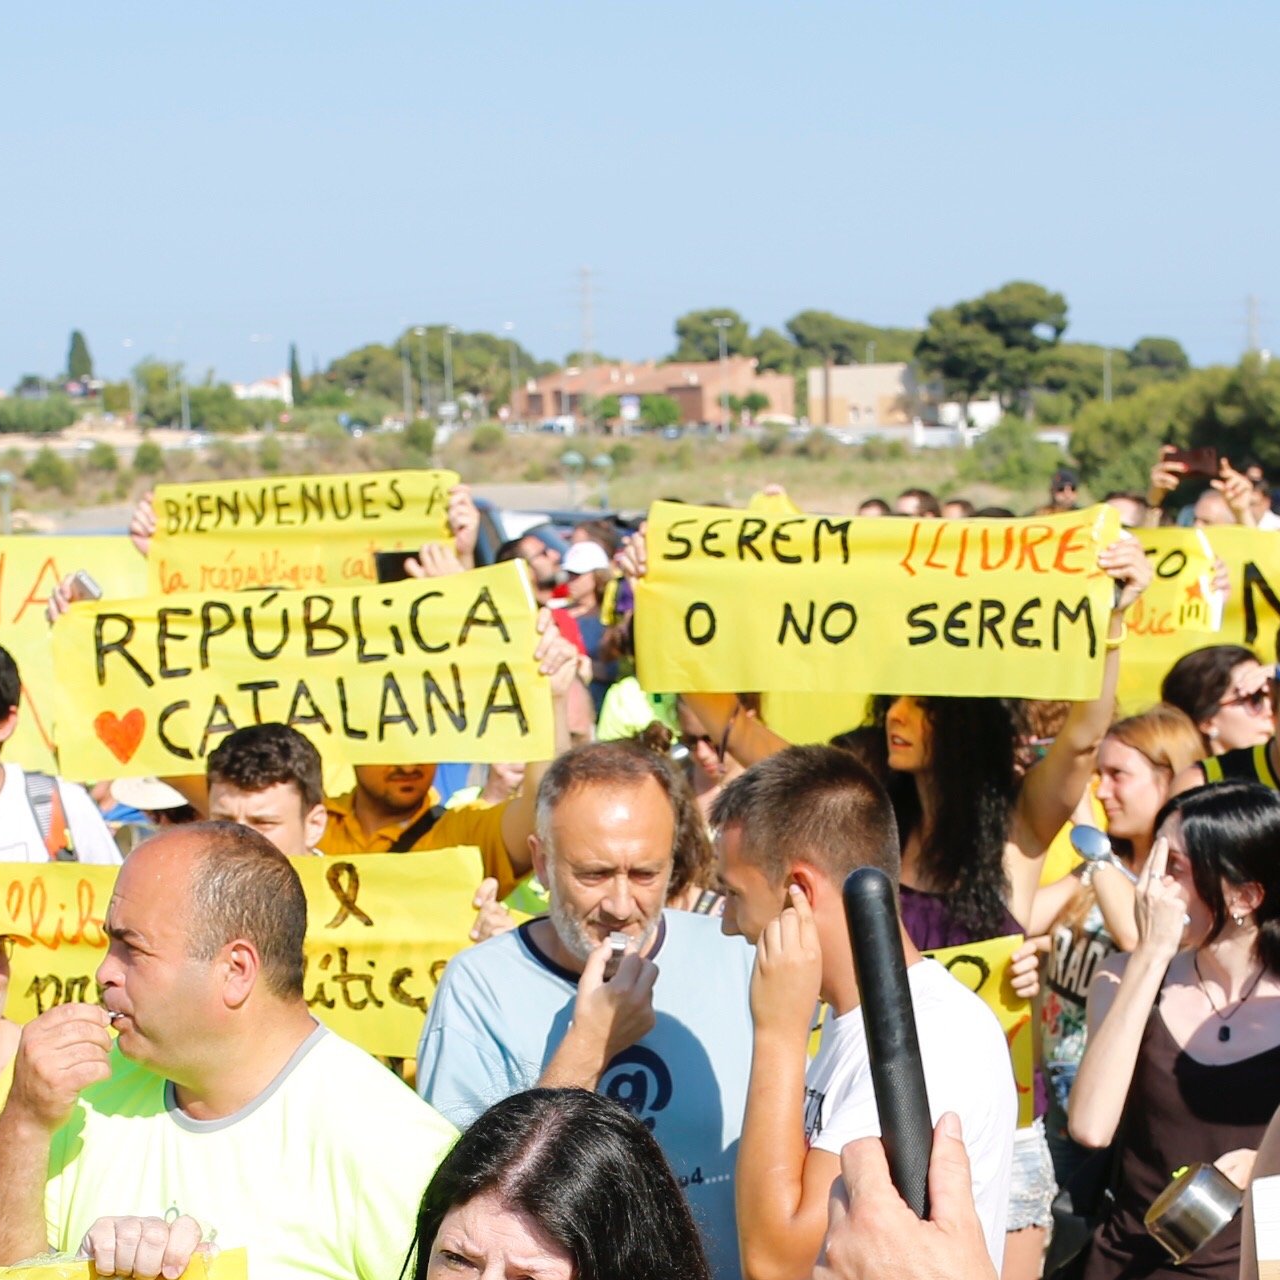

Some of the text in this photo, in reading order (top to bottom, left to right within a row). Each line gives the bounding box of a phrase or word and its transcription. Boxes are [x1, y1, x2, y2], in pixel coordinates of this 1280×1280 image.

[662, 517, 852, 564] SEREM
[684, 595, 1097, 658] O NO SEREM
[157, 661, 529, 760] CATALANA
